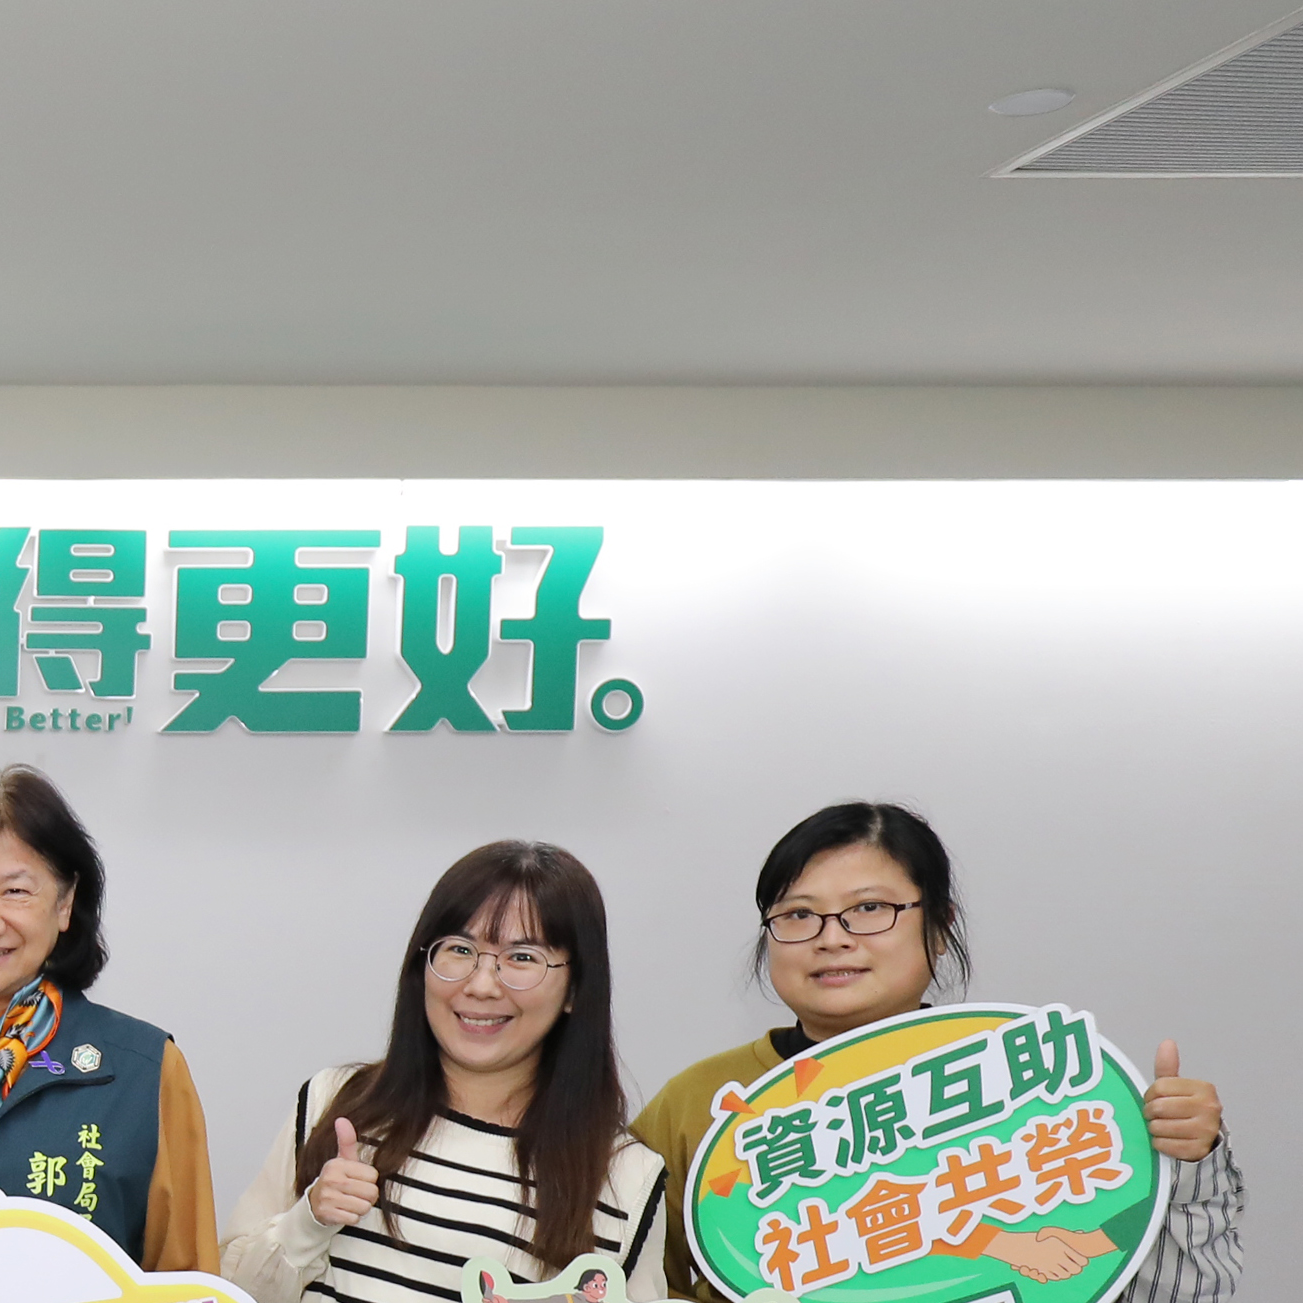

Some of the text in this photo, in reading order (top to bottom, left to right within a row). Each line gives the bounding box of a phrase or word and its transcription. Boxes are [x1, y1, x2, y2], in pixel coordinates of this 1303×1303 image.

[26, 1151, 67, 1197] 郭
[74, 1124, 105, 1220] 社會局
[743, 1011, 1094, 1200] 資源互助
[762, 1108, 1124, 1291] 社會共榮
